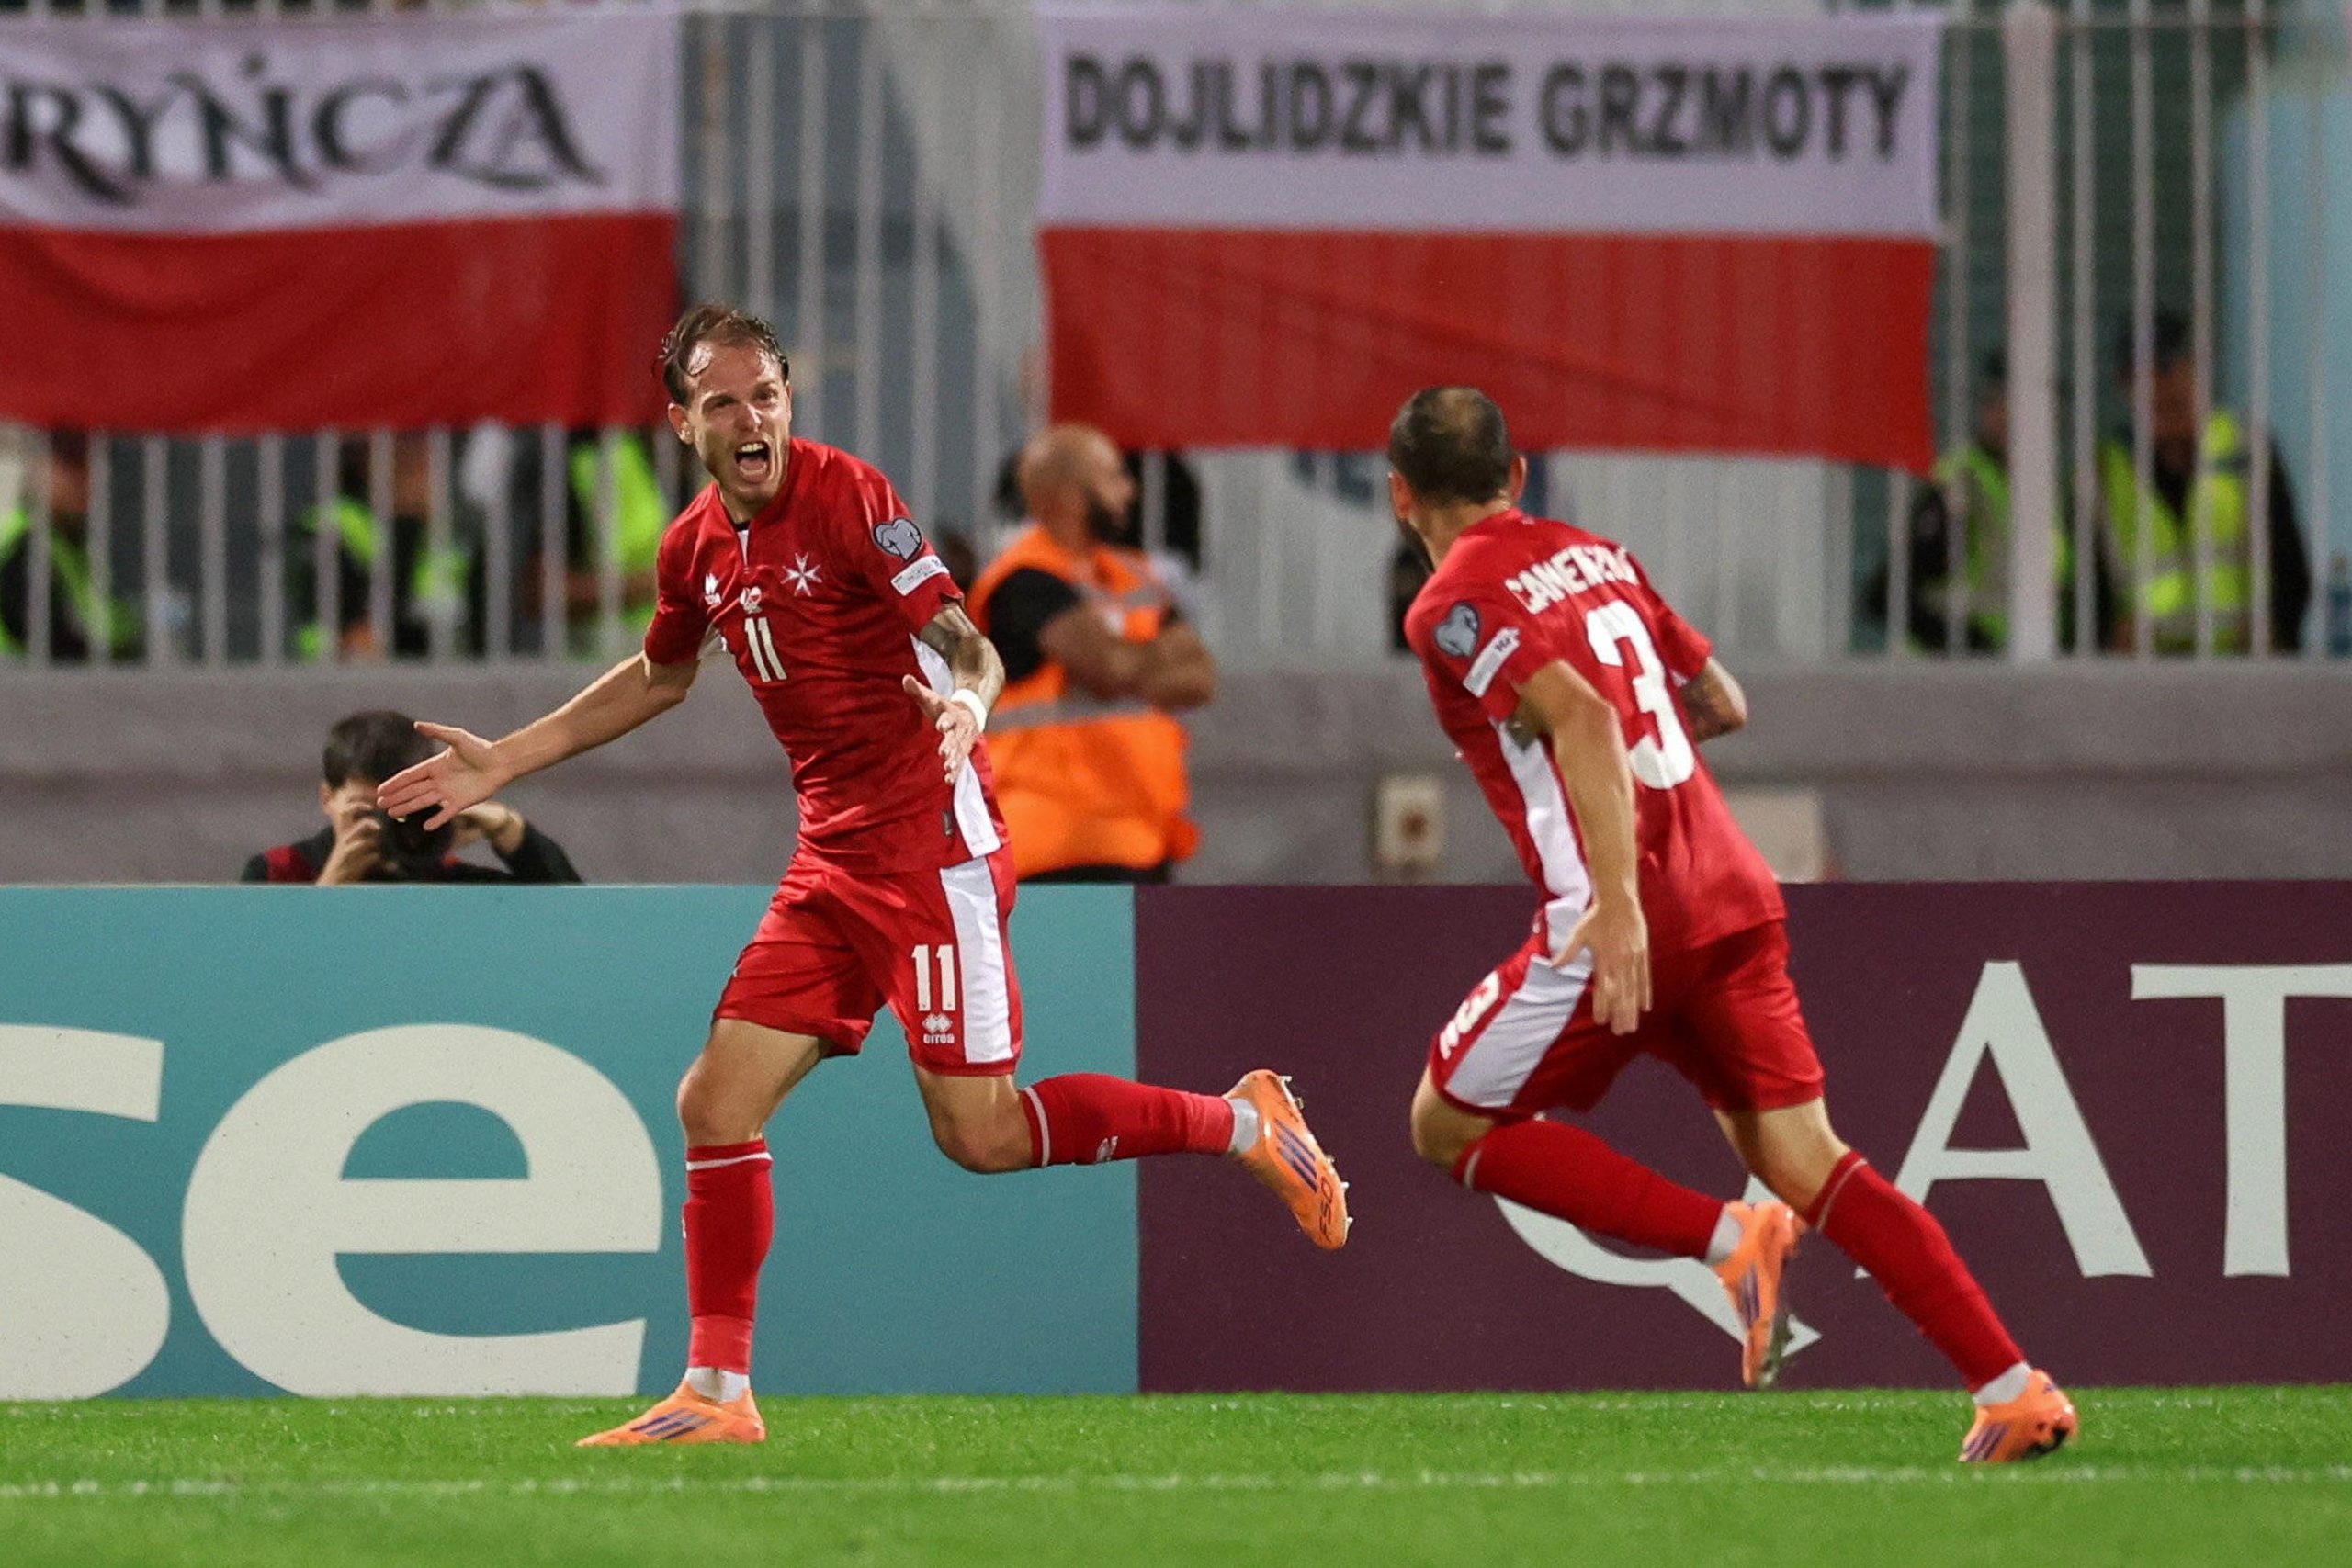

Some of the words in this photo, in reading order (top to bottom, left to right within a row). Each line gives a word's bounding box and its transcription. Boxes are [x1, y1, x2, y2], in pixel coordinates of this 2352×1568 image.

[1066, 57, 1511, 153] DOJLIDZKIE
[1540, 61, 1907, 160] GRZMOTY
[744, 616, 787, 682] 11
[1586, 599, 1695, 790] 3
[911, 944, 956, 1012] 11
